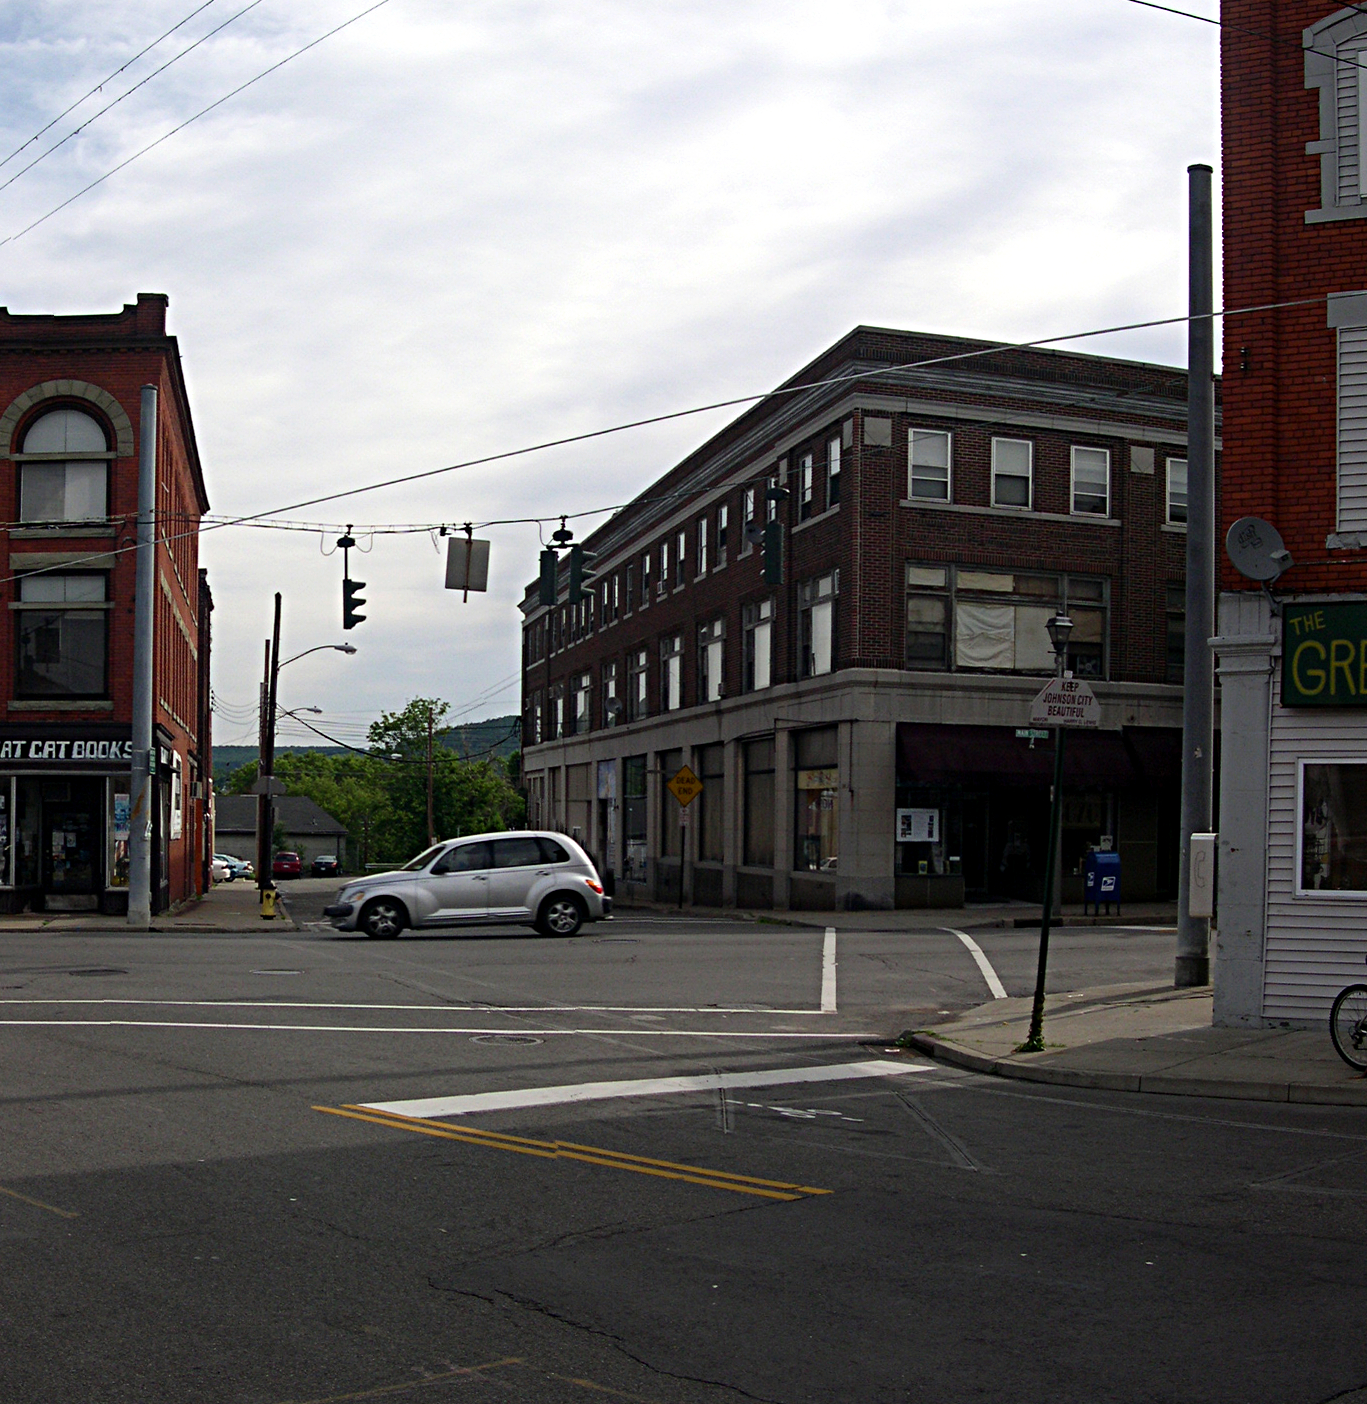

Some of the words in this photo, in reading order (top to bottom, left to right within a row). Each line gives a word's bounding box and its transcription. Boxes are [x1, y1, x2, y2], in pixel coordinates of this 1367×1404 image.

[1289, 610, 1327, 636] THE
[1061, 681, 1079, 692] KEEP
[1043, 693, 1076, 705] JOHNSON
[1077, 695, 1093, 706] CITY
[1047, 705, 1084, 718] BEAUTIFUL
[28, 740, 70, 759] CAT
[71, 740, 133, 759] BOOKS
[676, 776, 696, 784] DEAD
[678, 787, 693, 795] END
